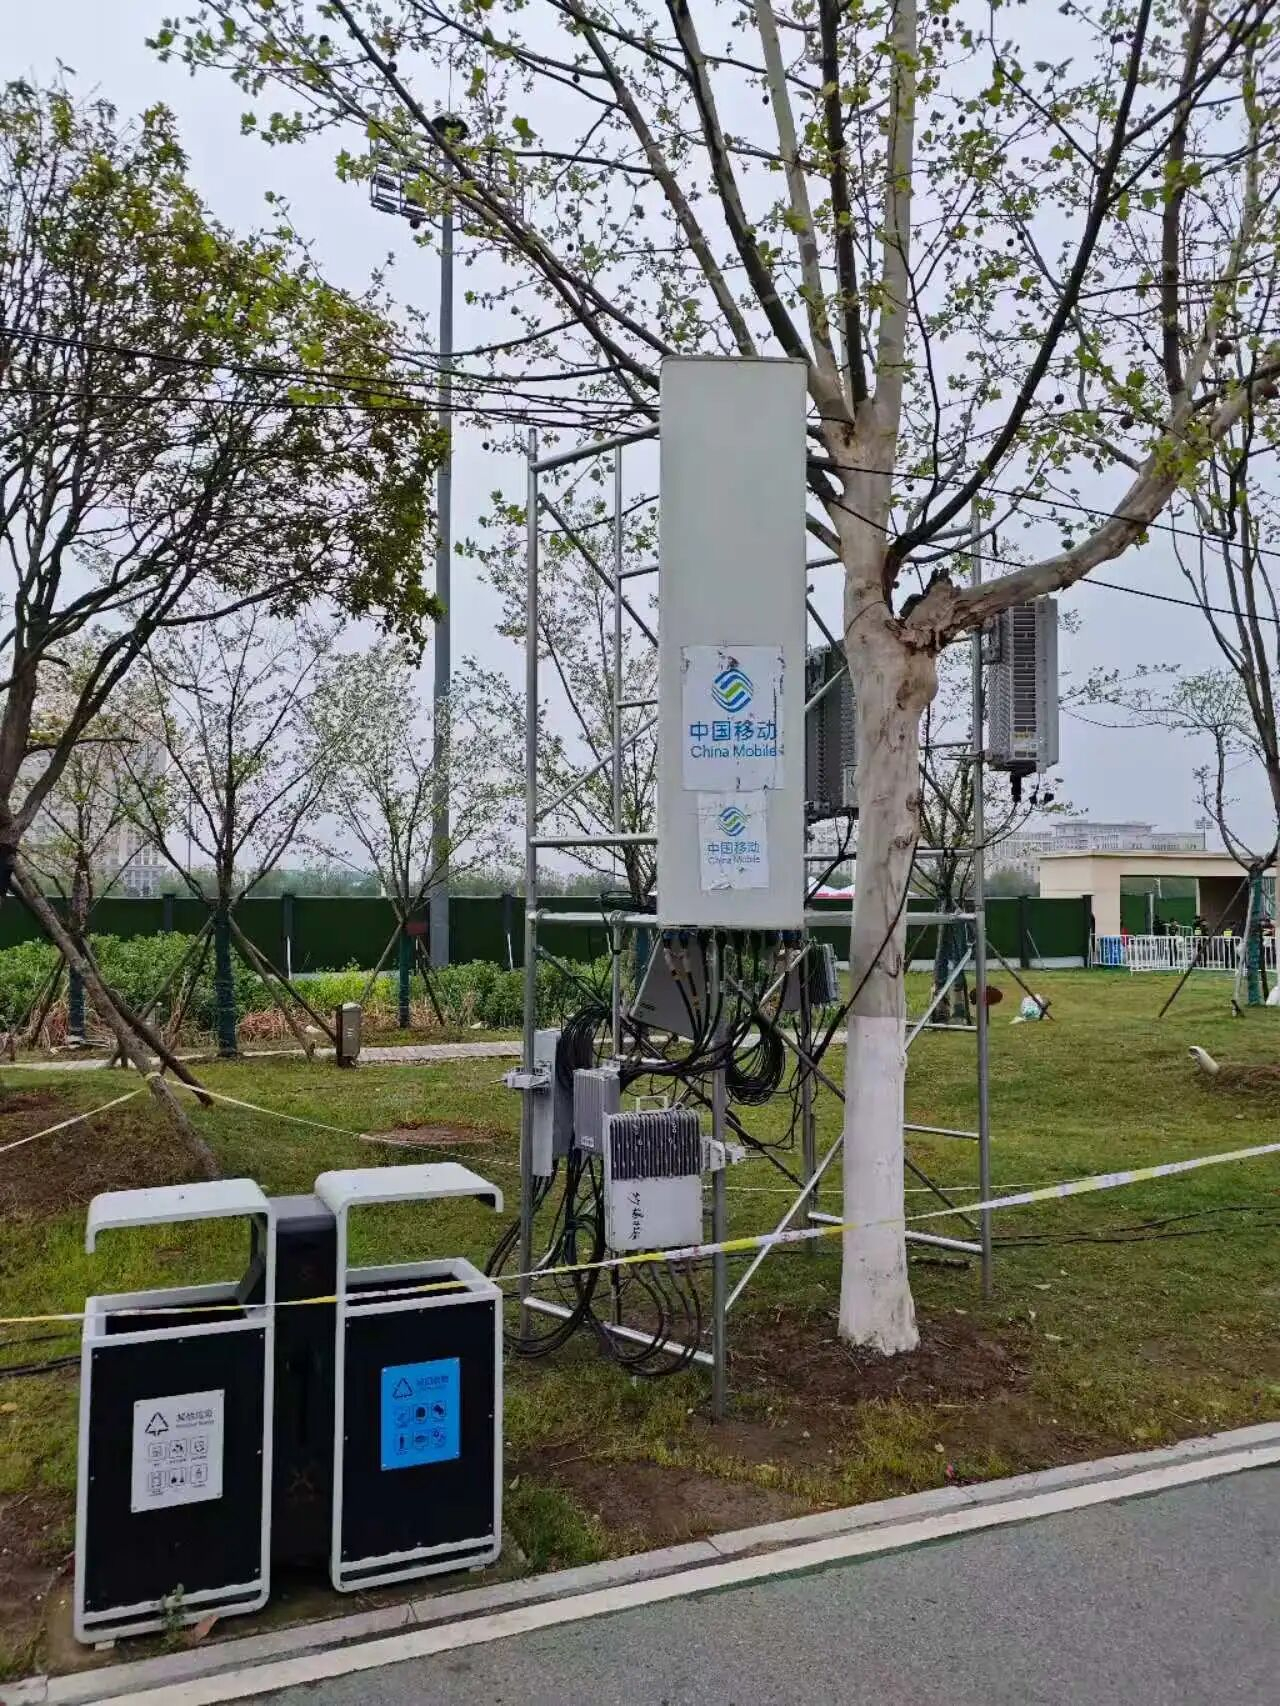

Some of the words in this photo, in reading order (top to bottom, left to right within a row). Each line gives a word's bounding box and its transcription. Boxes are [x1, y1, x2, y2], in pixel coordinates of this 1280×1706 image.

[690, 719, 776, 741] 中国移动
[690, 744, 730, 758] China
[733, 744, 777, 757] Mobile
[708, 840, 761, 855] 中国移动
